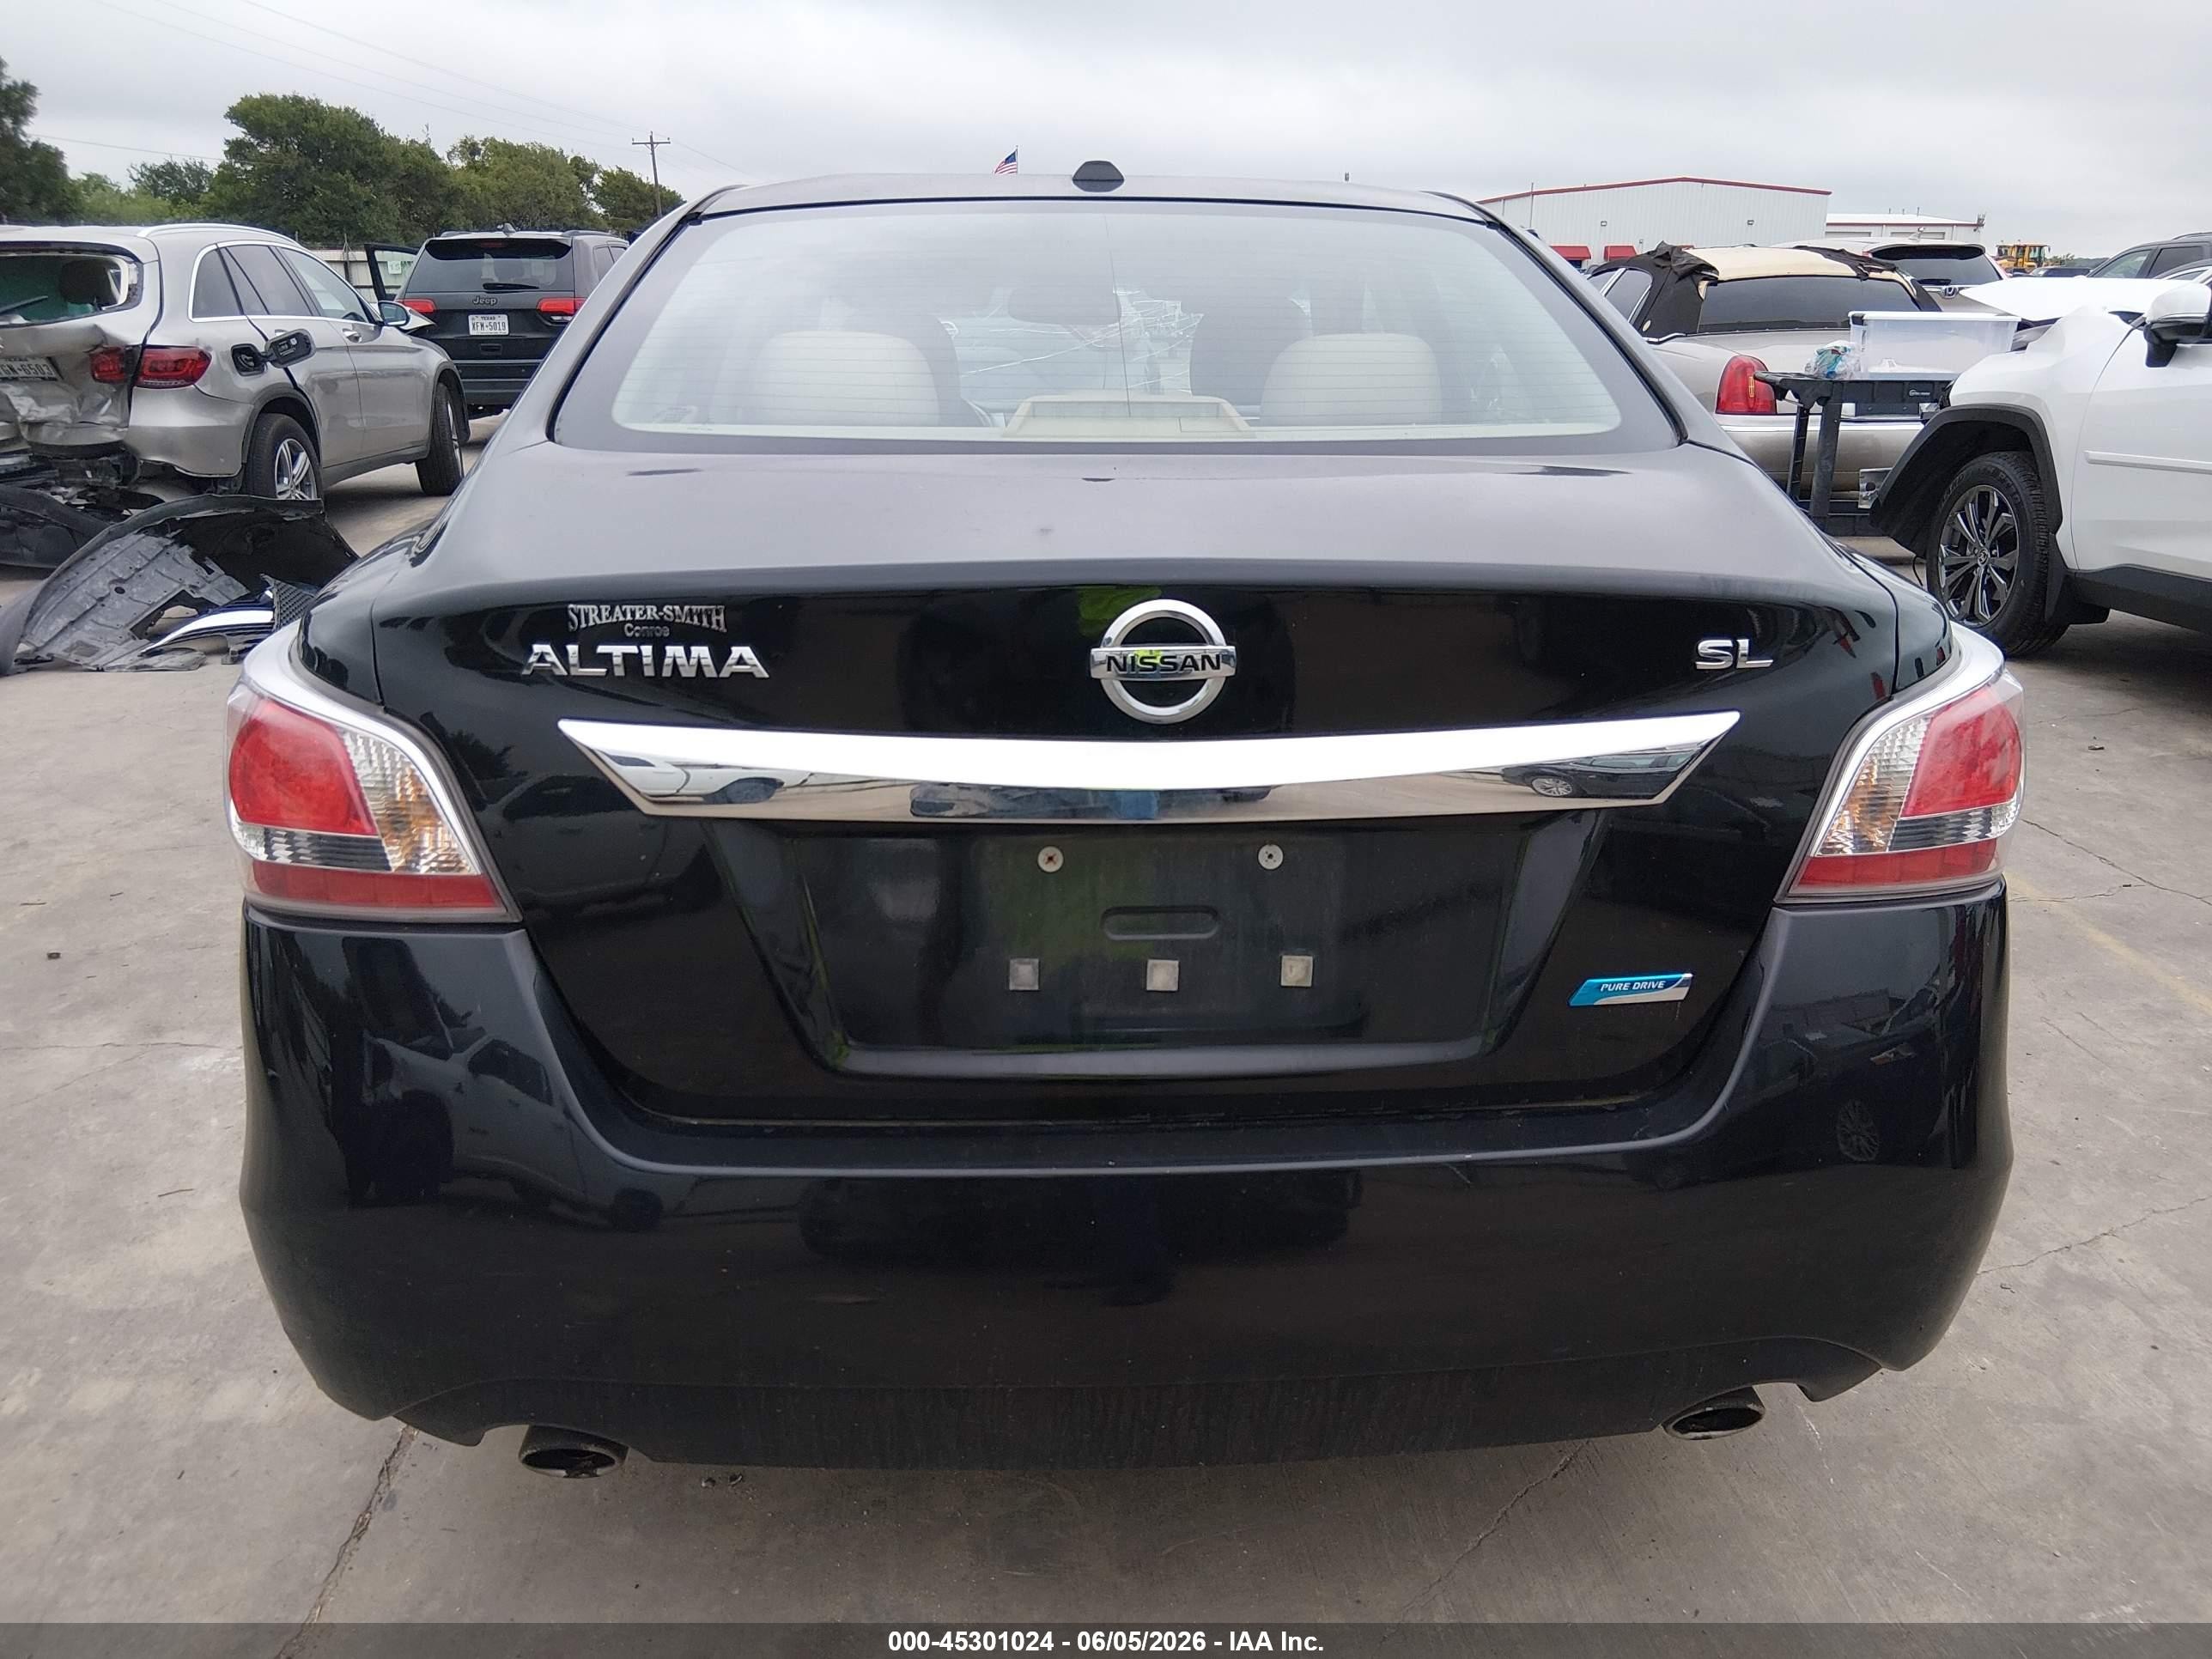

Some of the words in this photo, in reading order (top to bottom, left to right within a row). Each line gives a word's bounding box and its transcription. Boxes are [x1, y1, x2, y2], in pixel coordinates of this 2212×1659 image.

[473, 295, 497, 306] Jeep
[568, 604, 727, 632] STREATER-SMITH
[624, 623, 670, 637] Conroe
[521, 644, 770, 678] ALTIMA
[1106, 653, 1221, 672] NISSAN
[1695, 639, 1773, 669] SL
[1600, 982, 1631, 992] PURE
[1632, 980, 1667, 990] DRIVE
